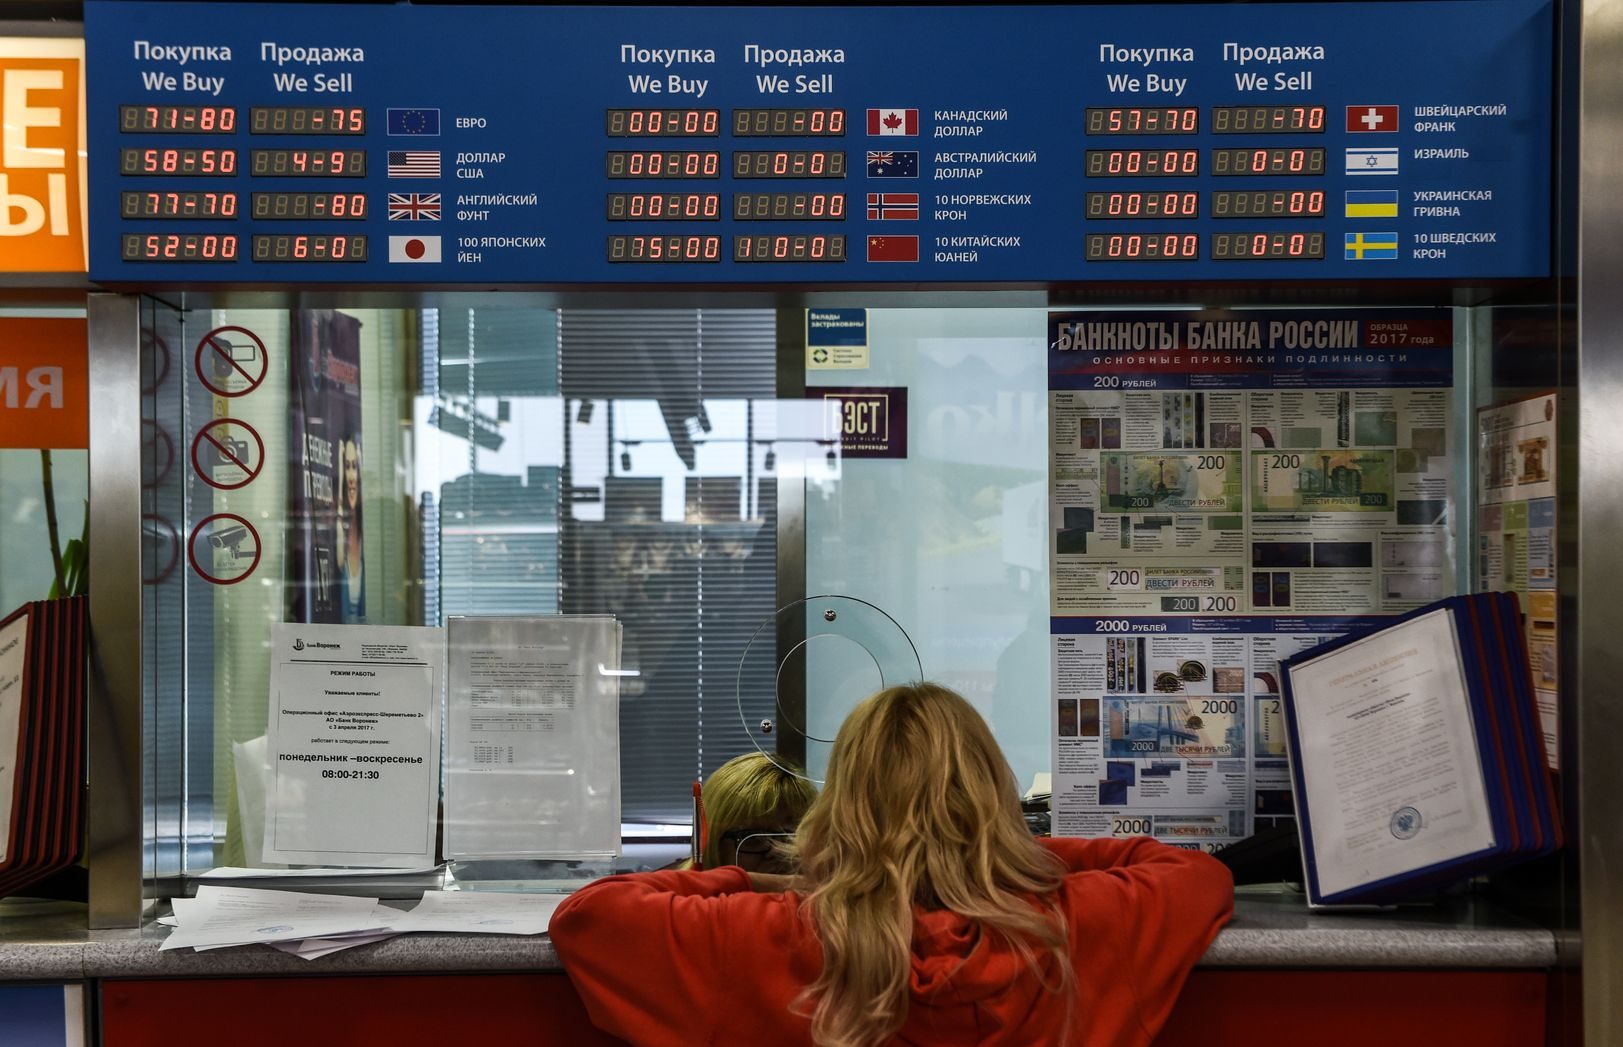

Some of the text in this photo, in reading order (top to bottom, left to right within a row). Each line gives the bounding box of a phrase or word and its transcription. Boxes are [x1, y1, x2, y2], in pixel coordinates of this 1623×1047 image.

[133, 40, 232, 62] Покупка
[260, 43, 365, 64] Продажа
[620, 44, 716, 66] Покупка
[744, 44, 846, 66] Продажа
[1099, 44, 1195, 65] Покупка
[1222, 42, 1326, 64] Продажа
[142, 72, 225, 96] We Buy
[274, 73, 353, 93] We Sell
[628, 75, 709, 98] We Buy
[756, 74, 834, 93] We Sell
[1107, 73, 1188, 97] We Buy
[1234, 72, 1313, 91] We Sell
[934, 108, 1009, 121] КАНАДСКИЙ
[1414, 104, 1507, 117] ШВЕЙЦАРСКИЙ
[146, 108, 235, 131] 71-80
[455, 117, 488, 129] ЕВРО
[629, 111, 717, 133] 00-00
[1109, 110, 1196, 132] 57-70
[934, 125, 983, 138] ДОЛЛАР
[1414, 121, 1457, 133] ФРАНК
[455, 152, 506, 165] ДОЛЛАР
[934, 150, 1037, 164] АВСТРАЛИЙСКИЙ
[1414, 147, 1469, 160] ИЗРАИЛЬ
[144, 150, 235, 172] 58-50
[293, 152, 345, 174] 4-9
[629, 153, 718, 175] 00-00
[774, 153, 825, 175] 0-0
[1108, 151, 1197, 173] 00-00
[1253, 150, 1304, 172] 0-0
[456, 167, 484, 180] США
[934, 167, 983, 180] ДОЛЛАР
[456, 192, 537, 206] АНГЛИЙСКИЙ
[935, 194, 1032, 206] 10 НОРВЕЖСКИХ
[1413, 190, 1493, 203] УКРАИНСКАЯ
[146, 193, 235, 216] 77-70
[630, 195, 718, 217] 00-00
[1109, 193, 1196, 215] 00-00
[457, 210, 490, 222] ФУНТ
[934, 210, 967, 221] КРОН
[1413, 205, 1461, 218] ГРИВНА
[457, 237, 546, 249] 100 ЯПОНСКИХ
[935, 234, 1021, 248] 10 КИТАЙСКИХ
[1253, 234, 1304, 256] 0-0
[1414, 231, 1497, 245] 10 ШВЕДСКИХ
[146, 235, 237, 258] 52-00
[294, 236, 346, 258] 6-0
[633, 237, 719, 258] 75-00
[1108, 235, 1197, 258] 00-00
[457, 250, 483, 263] ЙЕН
[934, 250, 979, 263] ЮАНЕЙ
[1413, 248, 1447, 260] КРОН
[1369, 322, 1408, 332] ОБРАЗЦА
[1057, 320, 1358, 351] БАНКНОТЫ БАНКА РОССИИ
[1369, 333, 1435, 346] 2017 года
[1092, 354, 1409, 365] ОСНОВНЫЕ ПРИЗНАКИ ПОДЛИННОСТИ
[1094, 376, 1157, 388] 200 РУБЛЕЙ
[1197, 455, 1225, 470] 200
[1271, 454, 1300, 469] 200
[1131, 497, 1149, 507] 200
[1110, 570, 1140, 586] 200
[1145, 577, 1215, 588] ДВЕСТИ РУБЛЕЙ
[1173, 598, 1196, 610] 200
[1206, 596, 1236, 612] 200
[1095, 620, 1167, 632] 2000 РУБЛЕЙ
[1201, 700, 1238, 714] 2000
[1131, 741, 1155, 751] 2000
[279, 753, 348, 763] понедельник
[321, 769, 380, 780] 08:00-21:30
[1113, 819, 1151, 834] 2000
[1169, 826, 1201, 836] ТЫСЯЧИ
